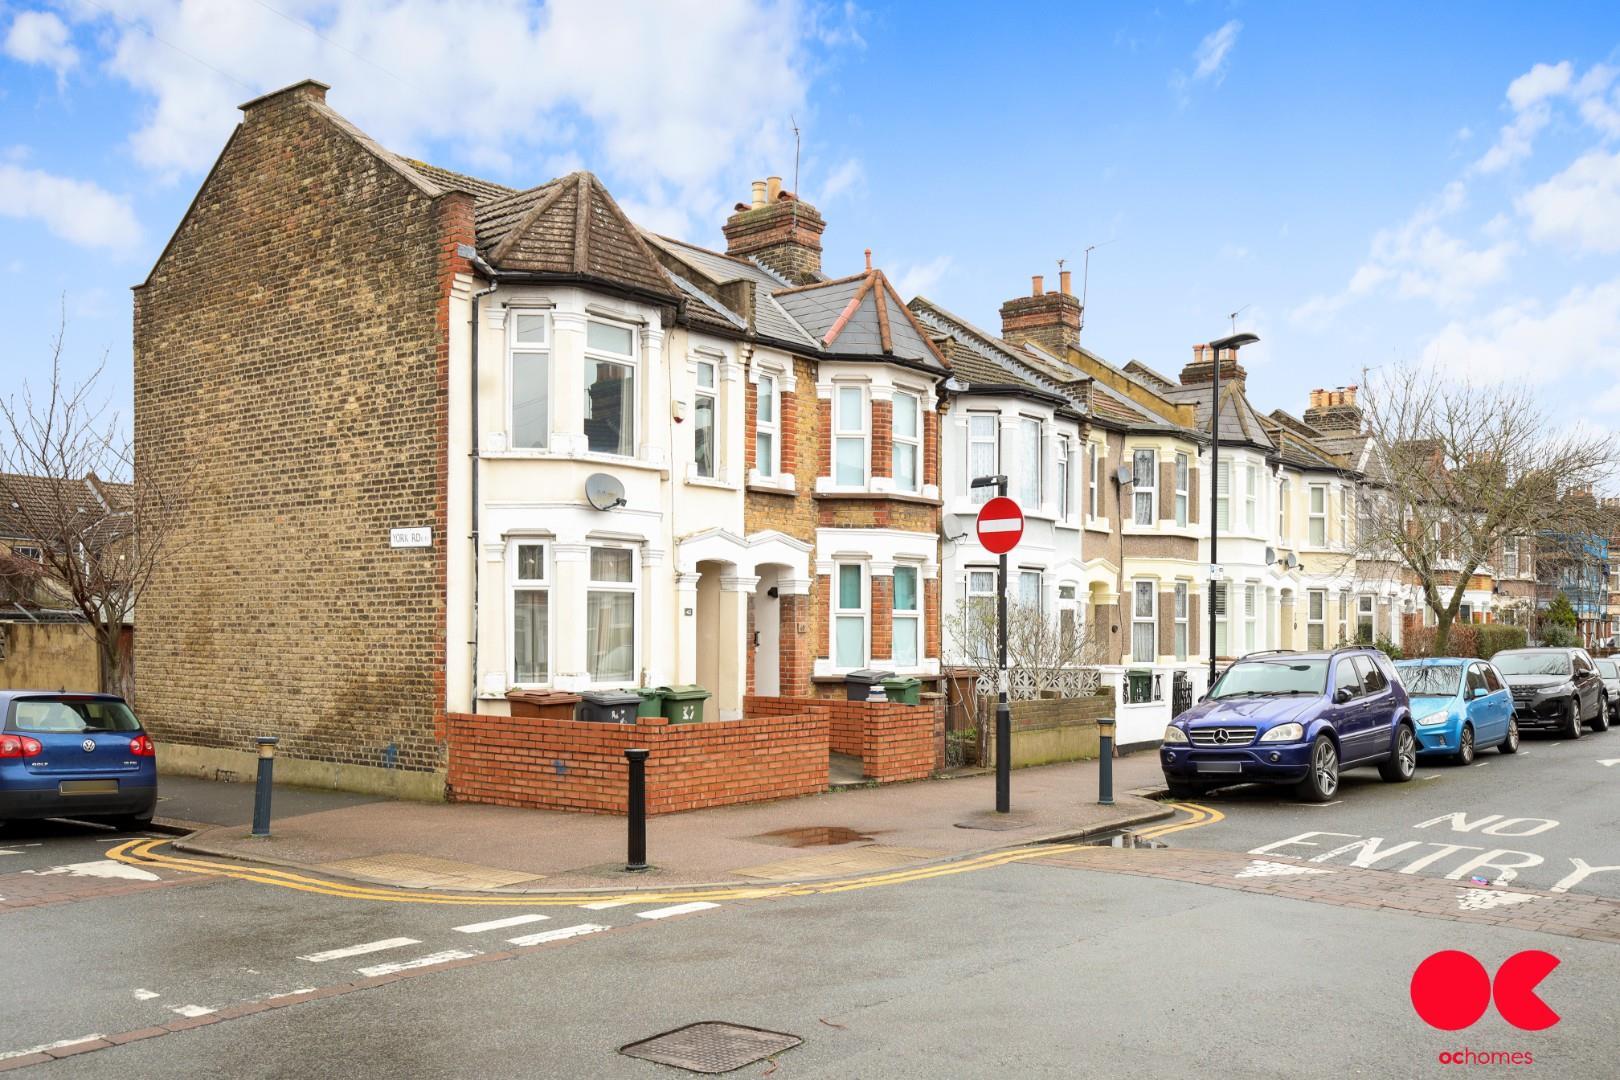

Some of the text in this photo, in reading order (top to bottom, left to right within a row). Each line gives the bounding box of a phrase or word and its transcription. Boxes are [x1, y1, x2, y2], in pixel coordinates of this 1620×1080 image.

[392, 533, 408, 543] YORK
[411, 532, 421, 543] RD
[1412, 811, 1560, 837] NO
[1247, 831, 1620, 893] ENTRY
